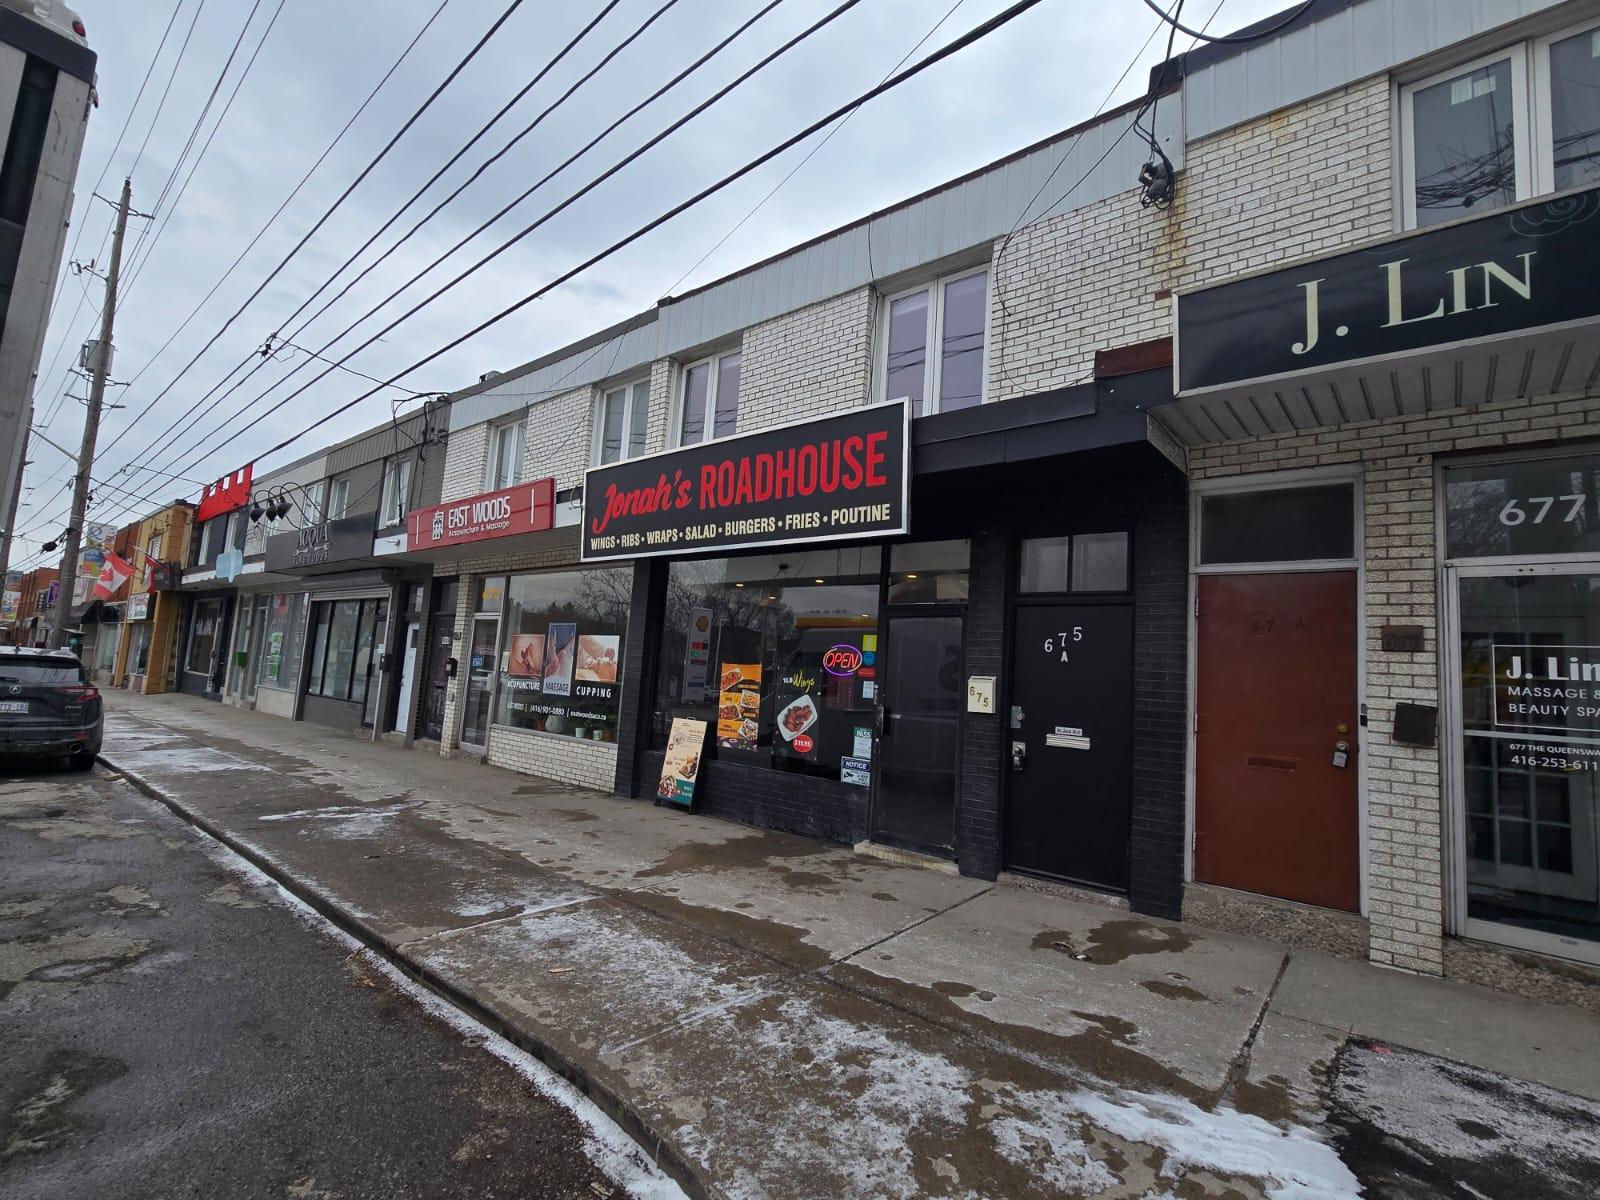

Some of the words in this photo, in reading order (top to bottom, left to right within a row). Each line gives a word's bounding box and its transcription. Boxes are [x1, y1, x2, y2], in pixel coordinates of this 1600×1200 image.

[1291, 279, 1349, 355] J.
[592, 469, 692, 534] Jonah's
[699, 431, 888, 511] ROADHOUSE
[448, 505, 470, 529] EAST
[472, 496, 511, 524] WOODS
[1499, 494, 1586, 526] 677
[590, 536, 616, 551] WINGS
[621, 533, 640, 548] RIBS
[646, 528, 678, 545] WRAPS
[685, 523, 717, 541] SALAD
[724, 516, 776, 536] BURGERS
[785, 511, 821, 530] FRIES
[831, 503, 891, 526] POUTINE
[825, 652, 859, 669] OPEN
[1060, 650, 1069, 662] A
[1506, 655, 1534, 680] J.
[1547, 656, 1600, 682] Lin
[507, 679, 541, 691] ACUPUNCTURE
[545, 681, 569, 693] MASSAGE
[793, 670, 815, 694] Wings
[576, 686, 612, 699] CUPPING
[1508, 686, 1588, 700] MASSAGE
[1509, 703, 1569, 716] BEAUTY
[856, 730, 871, 738] PASS
[1510, 743, 1526, 751] 677
[1527, 744, 1545, 753] THE
[845, 761, 868, 770] NOTICE
